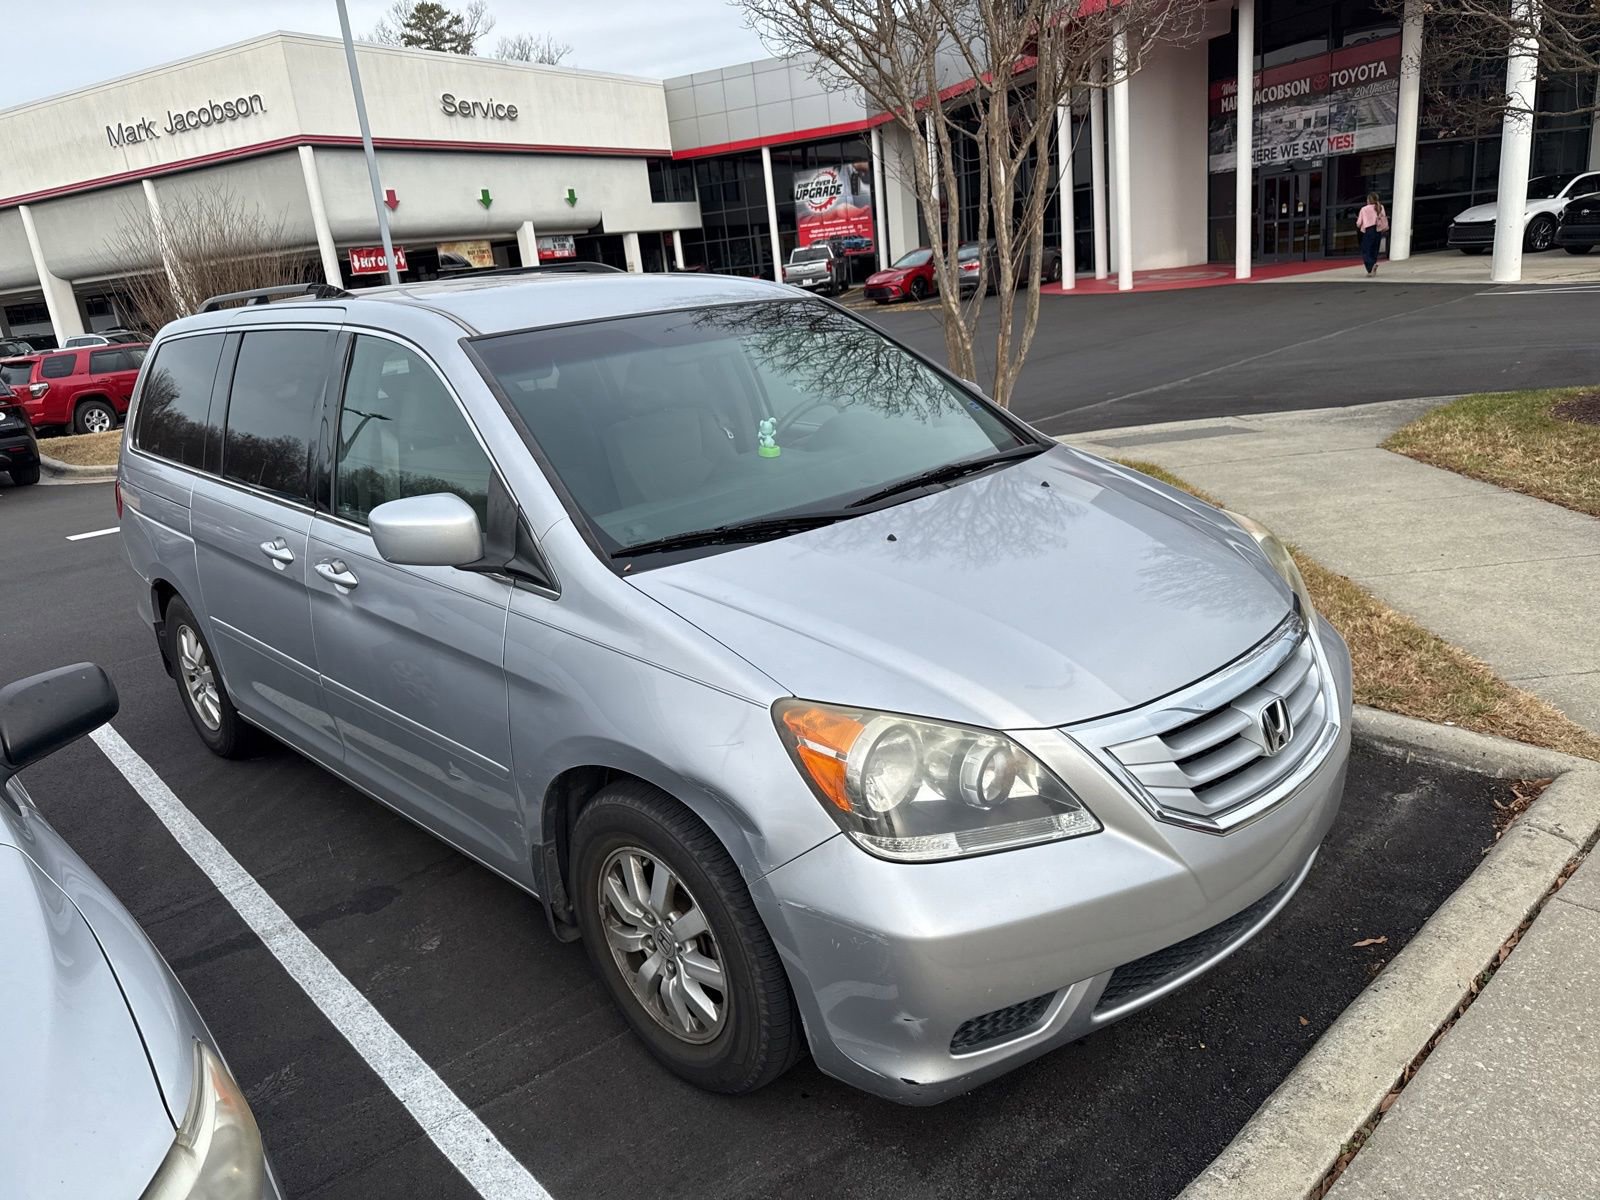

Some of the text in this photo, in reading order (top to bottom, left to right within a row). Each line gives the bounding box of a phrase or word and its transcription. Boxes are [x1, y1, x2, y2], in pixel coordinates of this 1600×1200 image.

[1252, 78, 1310, 106] ACOBSON
[1330, 60, 1388, 88] TOYOTA
[105, 93, 267, 148] Mark Jacobson
[441, 93, 519, 121] Service
[1280, 142, 1300, 159] WE
[1302, 138, 1325, 155] SAY
[1327, 133, 1355, 151] YES!
[795, 183, 843, 201] UPGRADE
